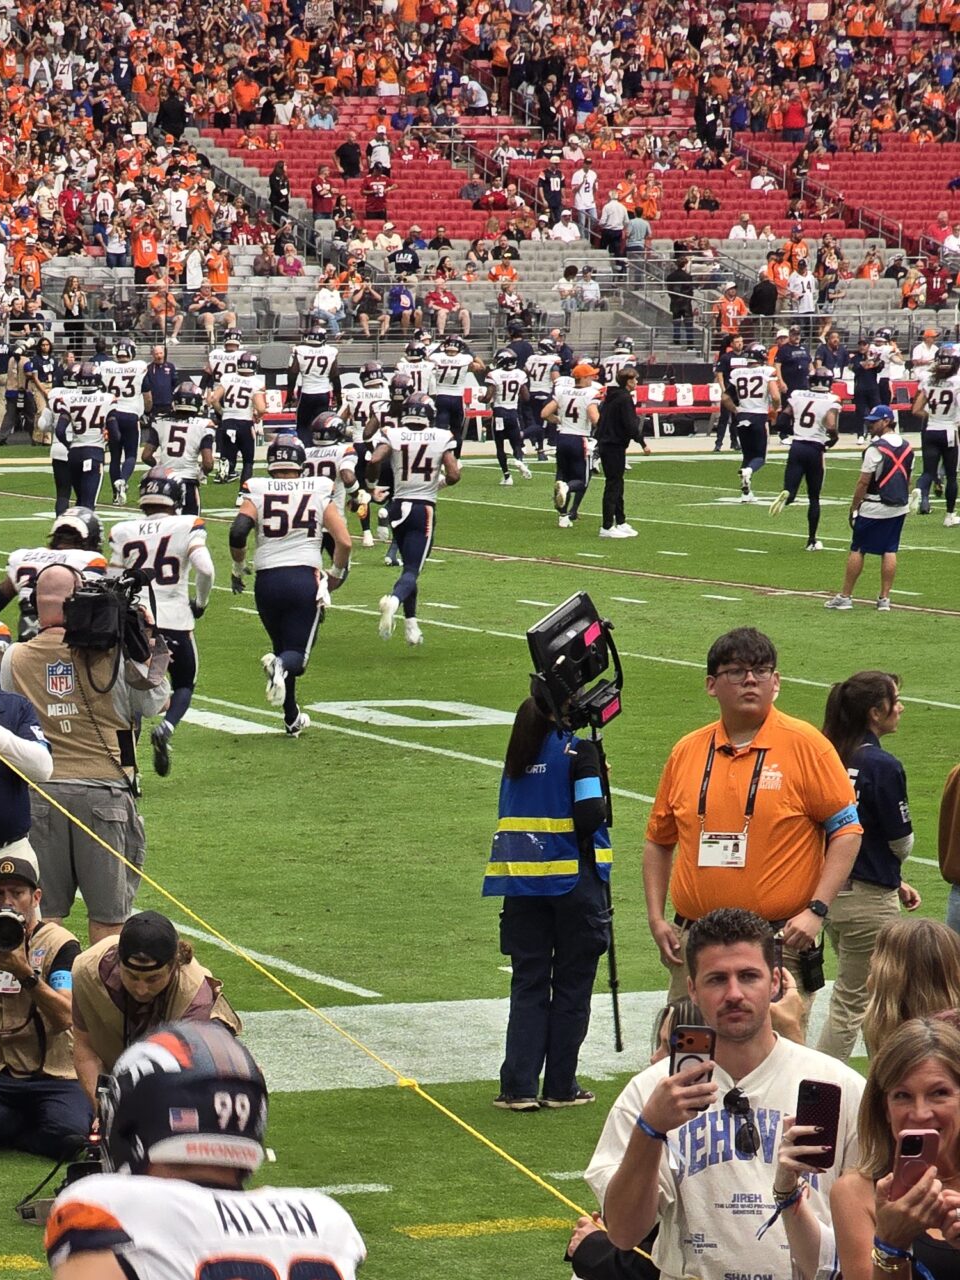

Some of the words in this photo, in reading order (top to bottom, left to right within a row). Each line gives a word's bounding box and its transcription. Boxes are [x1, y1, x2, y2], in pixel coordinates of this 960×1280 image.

[119, 64, 128, 78] 7
[550, 178, 560, 191] 10
[584, 182, 590, 193] 2
[175, 200, 183, 212] 2
[141, 240, 152, 253] 15
[801, 282, 812, 294] 14
[932, 277, 940, 288] 11
[304, 356, 330, 375] 79
[531, 363, 547, 382] 47
[438, 366, 462, 385] 77
[108, 375, 136, 398] 63
[502, 380, 520, 401] 19
[736, 376, 764, 399] 82
[225, 385, 253, 409] 45
[928, 388, 954, 415] 49
[565, 398, 580, 423] 4
[800, 400, 816, 428] 6
[70, 405, 105, 435] 34
[166, 425, 188, 458] 5
[400, 431, 436, 442] SUTTON
[276, 450, 288, 460] 54
[400, 443, 434, 482] 14
[146, 481, 159, 494] 26
[267, 481, 315, 491] FORSYTH
[262, 494, 318, 538] 54
[139, 522, 161, 535] KEY
[21, 551, 68, 563] BARRON
[122, 535, 180, 586] 26
[50, 676, 72, 692] NFL
[47, 703, 79, 717] MEDIA
[59, 719, 72, 734] 10
[214, 1090, 251, 1132] 99
[731, 1193, 763, 1203] JIREH
[212, 1193, 319, 1239] ALLEN
